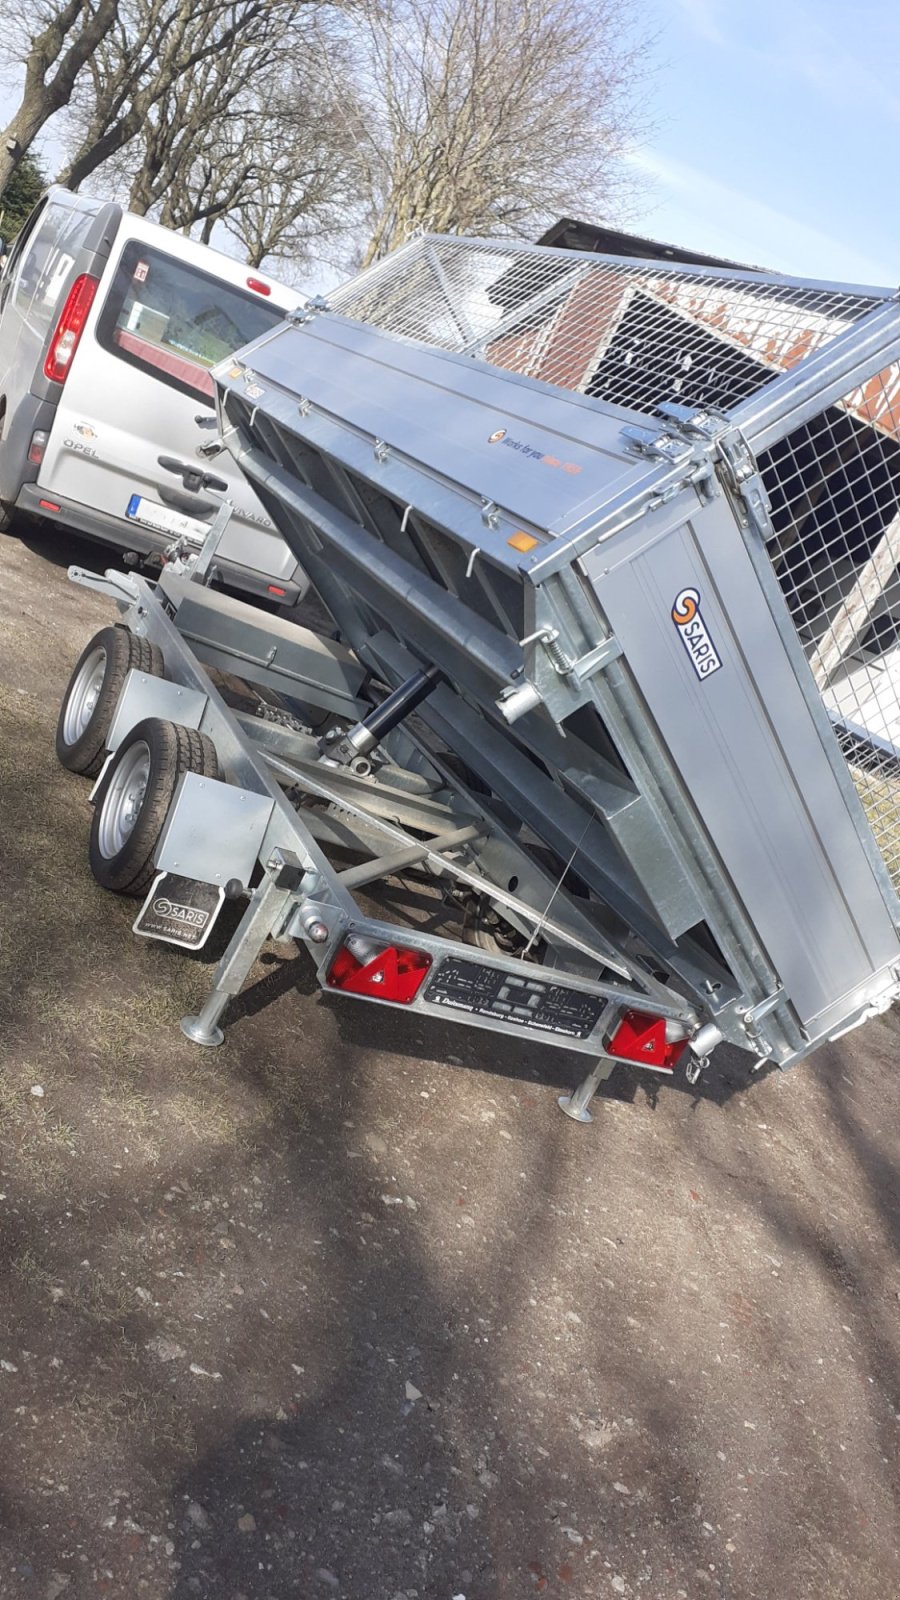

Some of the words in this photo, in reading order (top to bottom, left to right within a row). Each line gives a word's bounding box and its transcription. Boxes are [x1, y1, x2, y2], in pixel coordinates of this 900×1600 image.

[63, 439, 100, 459] OPEL
[684, 621, 716, 674] SARIS
[171, 907, 205, 925] SARIS
